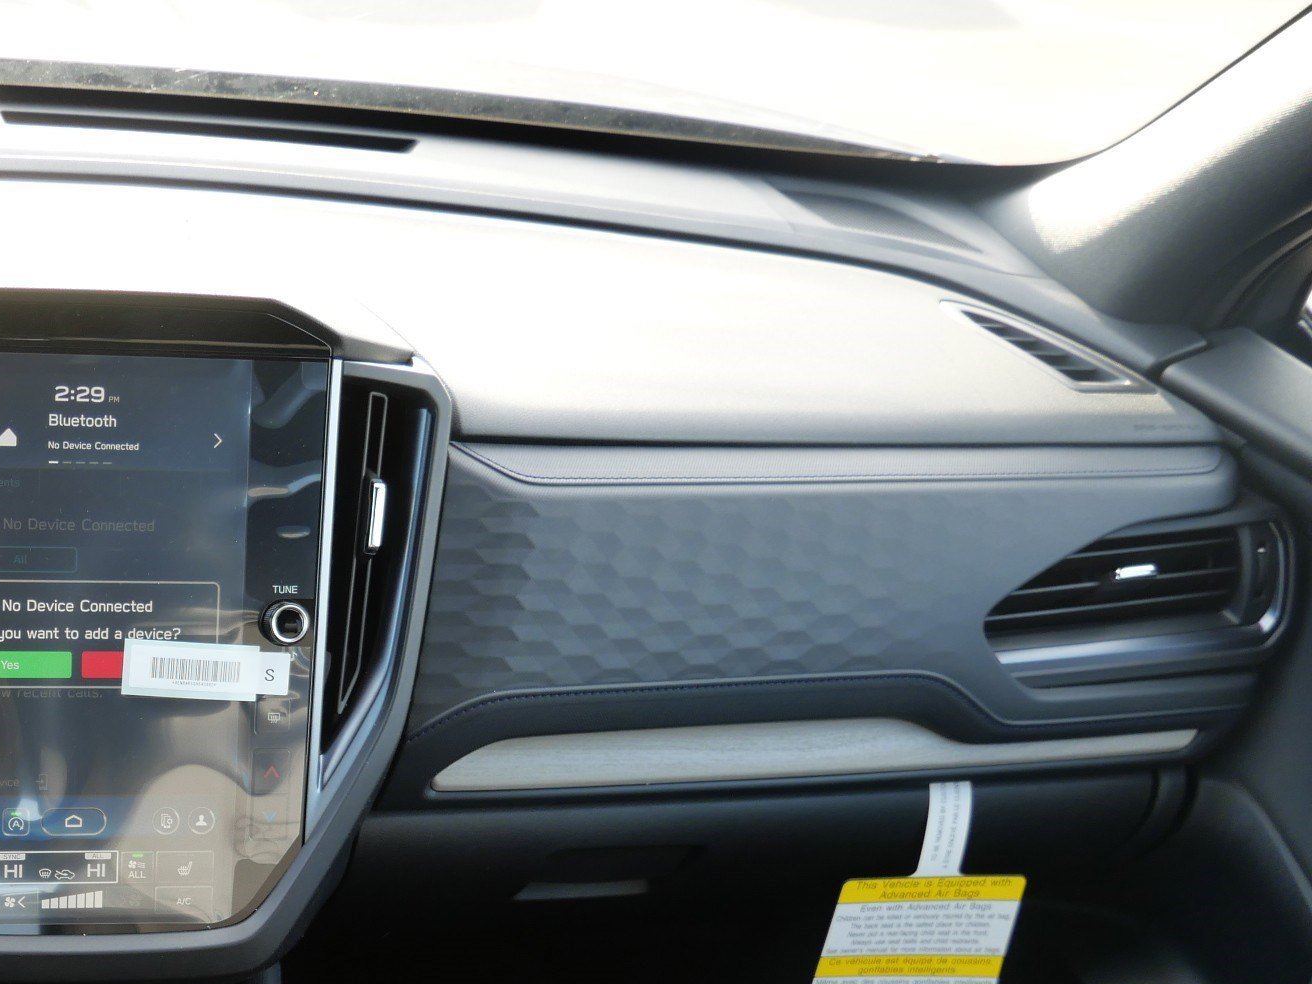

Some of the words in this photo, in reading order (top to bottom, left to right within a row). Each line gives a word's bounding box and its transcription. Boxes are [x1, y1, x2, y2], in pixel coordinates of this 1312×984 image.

[54, 386, 105, 403] 2:29
[48, 413, 117, 428] Bluetooth
[48, 441, 60, 449] No
[62, 441, 92, 450] Device
[94, 442, 139, 451] Connected
[3, 518, 22, 530] No
[28, 518, 75, 531] Device
[82, 519, 155, 532] Connected
[272, 585, 298, 594] TUNE
[2, 599, 21, 612] No
[26, 600, 74, 612] Device
[80, 600, 153, 613] Connected
[27, 627, 59, 640] want
[65, 628, 79, 640] to
[85, 627, 109, 640] add
[114, 630, 122, 640] a
[128, 628, 181, 640] device?
[0, 660, 20, 670] Yes
[264, 669, 275, 681] S
[3, 863, 23, 879] HI
[87, 863, 106, 878] HI
[128, 870, 146, 879] ALL
[857, 881, 877, 890] This
[883, 880, 919, 888] Vehicle
[937, 878, 987, 889] Equipped
[990, 878, 1013, 887] with
[879, 889, 930, 899] Advanced
[936, 889, 950, 898] Air
[954, 889, 980, 899] Bags
[860, 904, 882, 912] Even
[907, 903, 950, 911] Advanced
[969, 902, 992, 911] Bags
